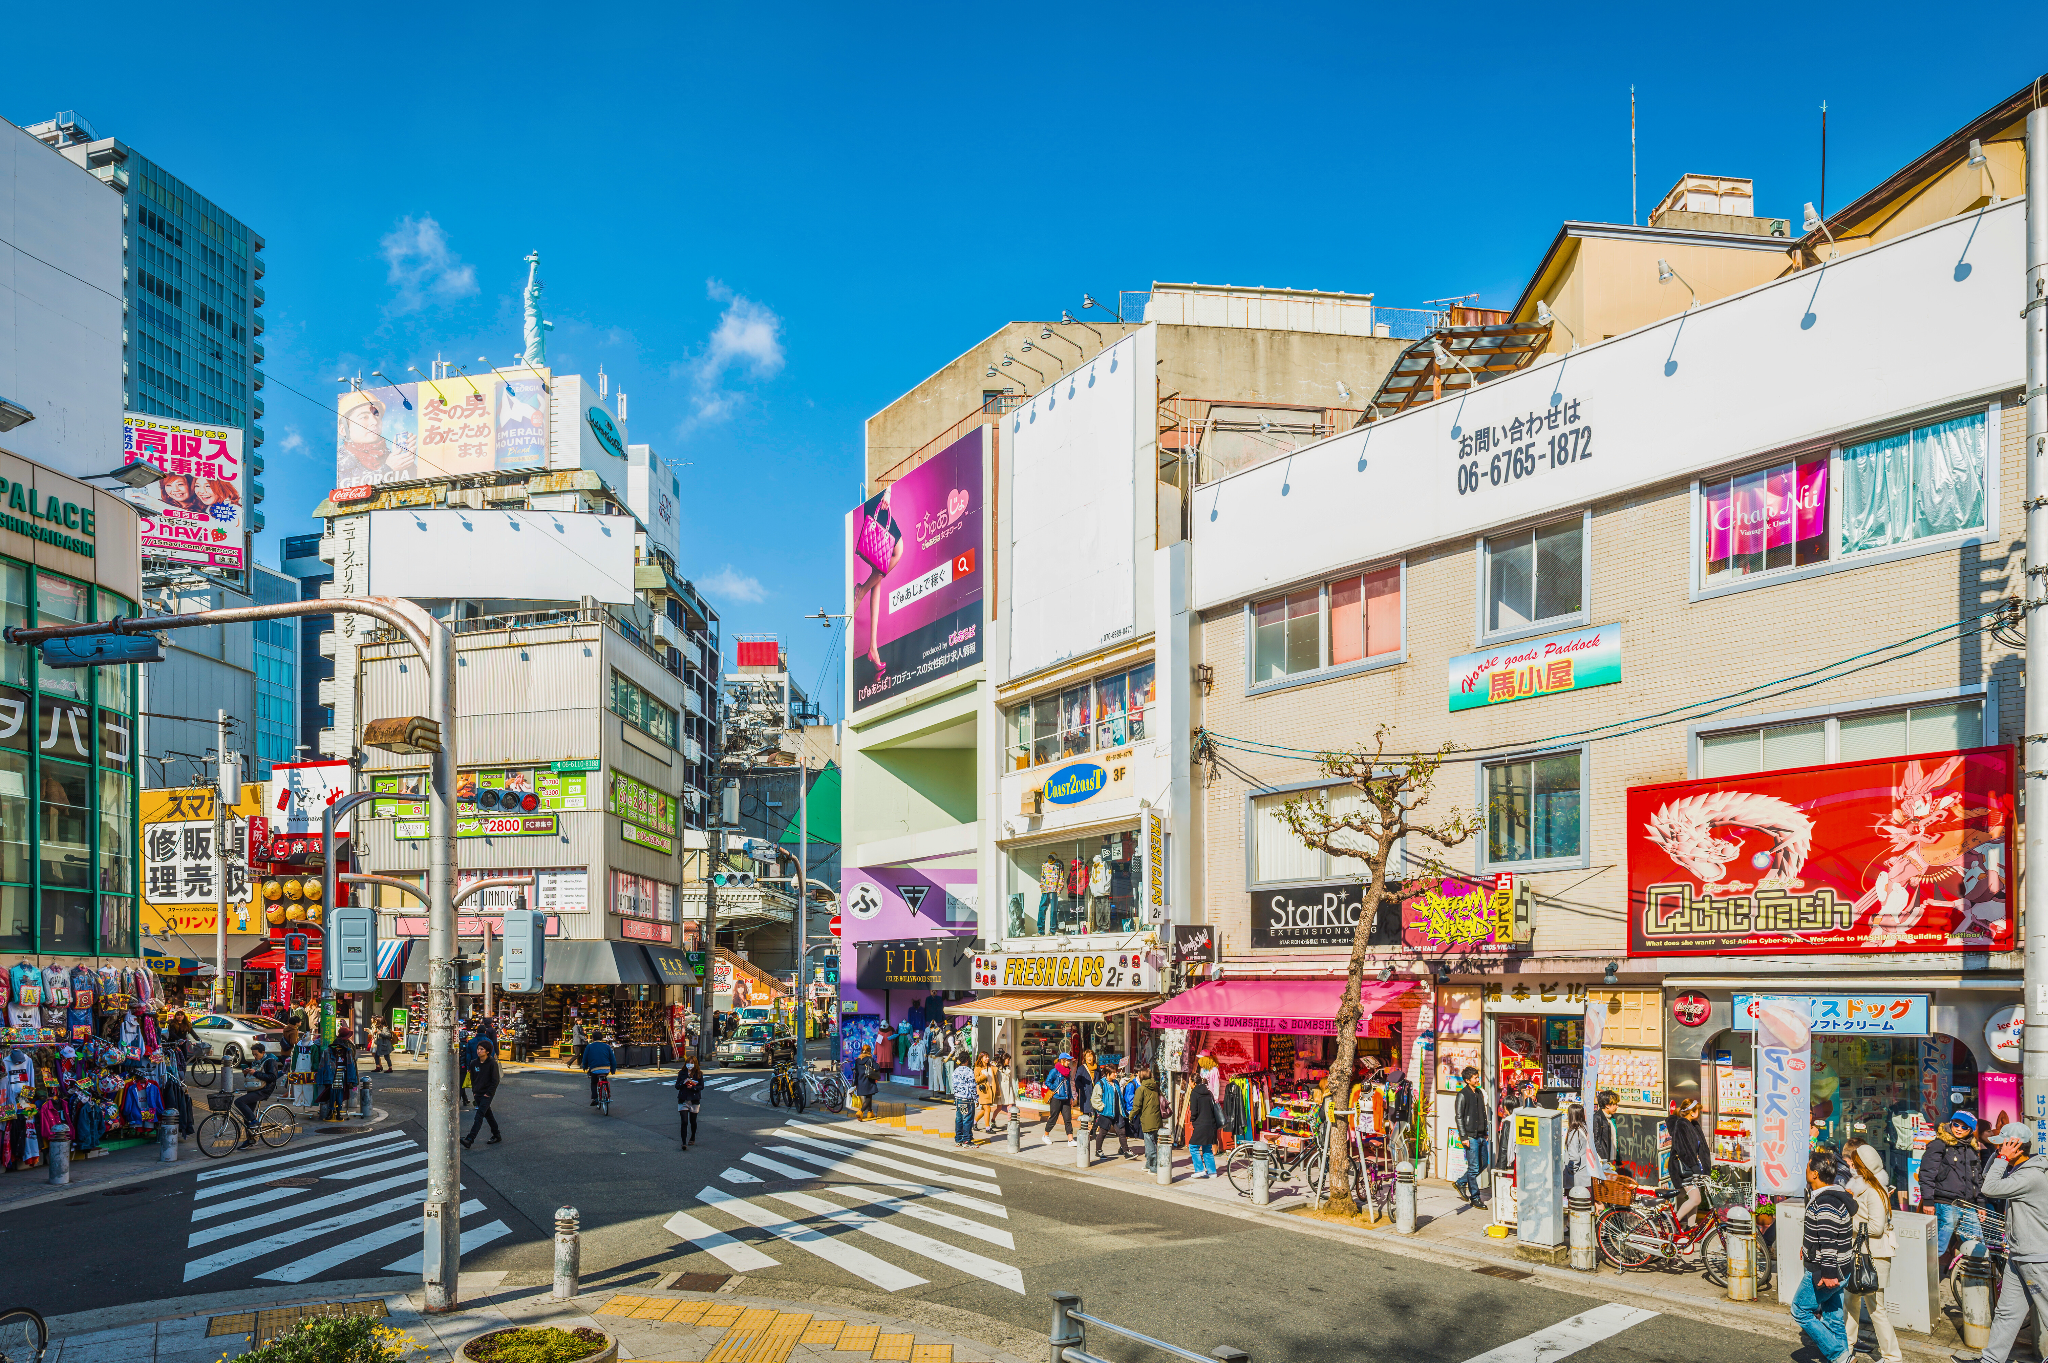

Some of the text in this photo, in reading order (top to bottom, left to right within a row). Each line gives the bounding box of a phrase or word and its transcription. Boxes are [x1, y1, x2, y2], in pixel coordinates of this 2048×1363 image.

[422, 393, 491, 423] 冬の男、
[124, 418, 227, 439] オファーメールあり
[422, 422, 492, 446] あたため
[497, 428, 544, 440] EMERALD
[1459, 398, 1580, 459] お問い合わせは
[124, 427, 133, 450] 女性の
[135, 428, 237, 465] 高収入
[457, 441, 489, 459] ます。
[1458, 426, 1592, 495] 06-6765-1872
[340, 469, 411, 490] GEORGIA
[332, 486, 369, 501] Coca-Cola
[1773, 517, 1791, 528] Used
[0, 511, 94, 558] SHINSAIBASHI
[923, 643, 941, 659] produced
[1462, 633, 1601, 693] Horse goods Paddock
[1488, 658, 1575, 702] 馬小屋
[1113, 767, 1126, 782] 3F
[525, 821, 553, 829] FC募集中
[258, 841, 320, 857] たこ焼き
[148, 828, 177, 898] 修理
[182, 827, 213, 898] 販売
[1151, 814, 1163, 907] FRESH CAPS
[1498, 874, 1511, 889] 占
[1756, 879, 1805, 889] フラッシュ
[1152, 908, 1162, 919] 2F
[1270, 887, 1378, 928] StarRic
[1497, 892, 1512, 939] ラピス
[1270, 928, 1341, 936] EXTENSION
[1810, 935, 1845, 943] Welcome
[1004, 956, 1123, 987] FRESH CAPS 2F
[1484, 982, 1585, 1003] 橋本ビル
[1163, 1015, 1210, 1026] BOMBSHELL
[1224, 1018, 1275, 1028] BOMBSHELL
[1291, 1020, 1336, 1030] BOMBSHE
[1997, 1019, 2025, 1031] ice do
[2013, 1028, 2020, 1036] &
[1997, 1039, 2013, 1050] soft
[1994, 1076, 2007, 1084] dog
[1519, 1119, 1535, 1138] 占
[2036, 1094, 2047, 1155] はり紙禁止
